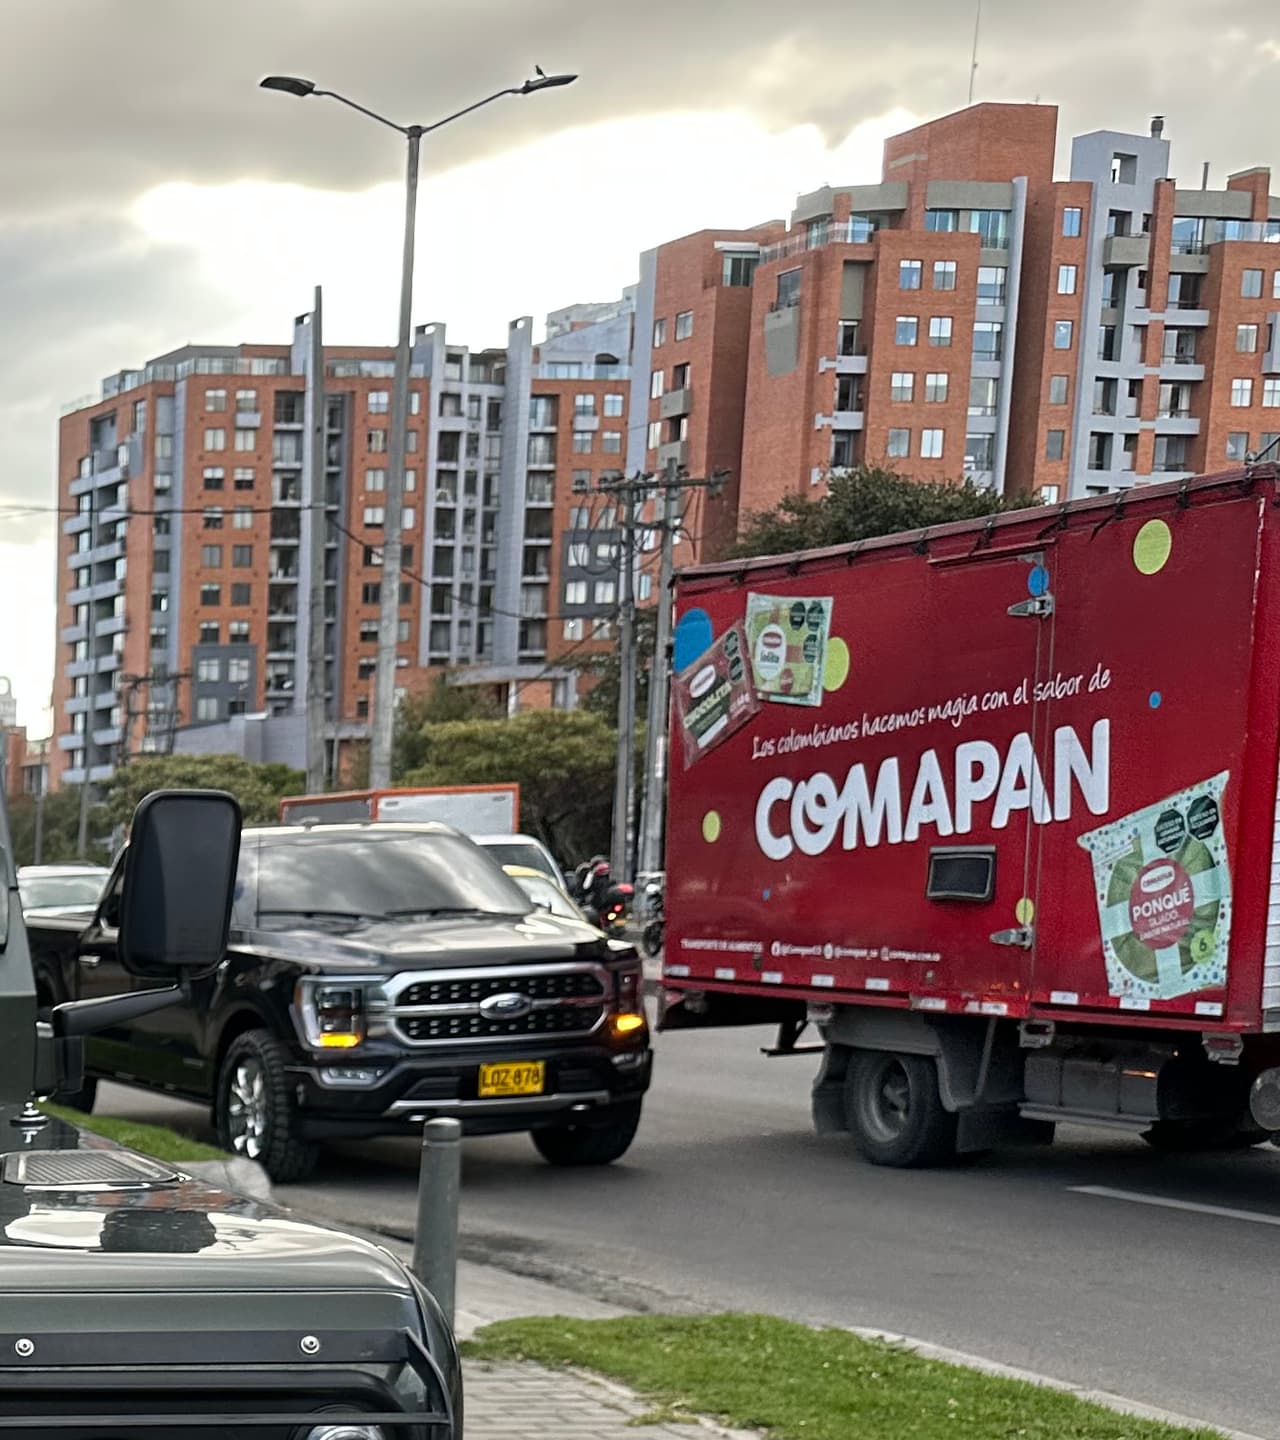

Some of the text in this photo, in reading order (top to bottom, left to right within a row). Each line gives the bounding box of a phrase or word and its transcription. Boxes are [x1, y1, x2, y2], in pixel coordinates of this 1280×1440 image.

[751, 662, 1111, 760] Los colombianos hacemos magia con el sabor de
[754, 718, 1111, 861] COMAPAN
[1132, 881, 1191, 922] PONQUÉ
[1198, 938, 1207, 951] 6
[482, 1066, 540, 1088] LOZ 878
